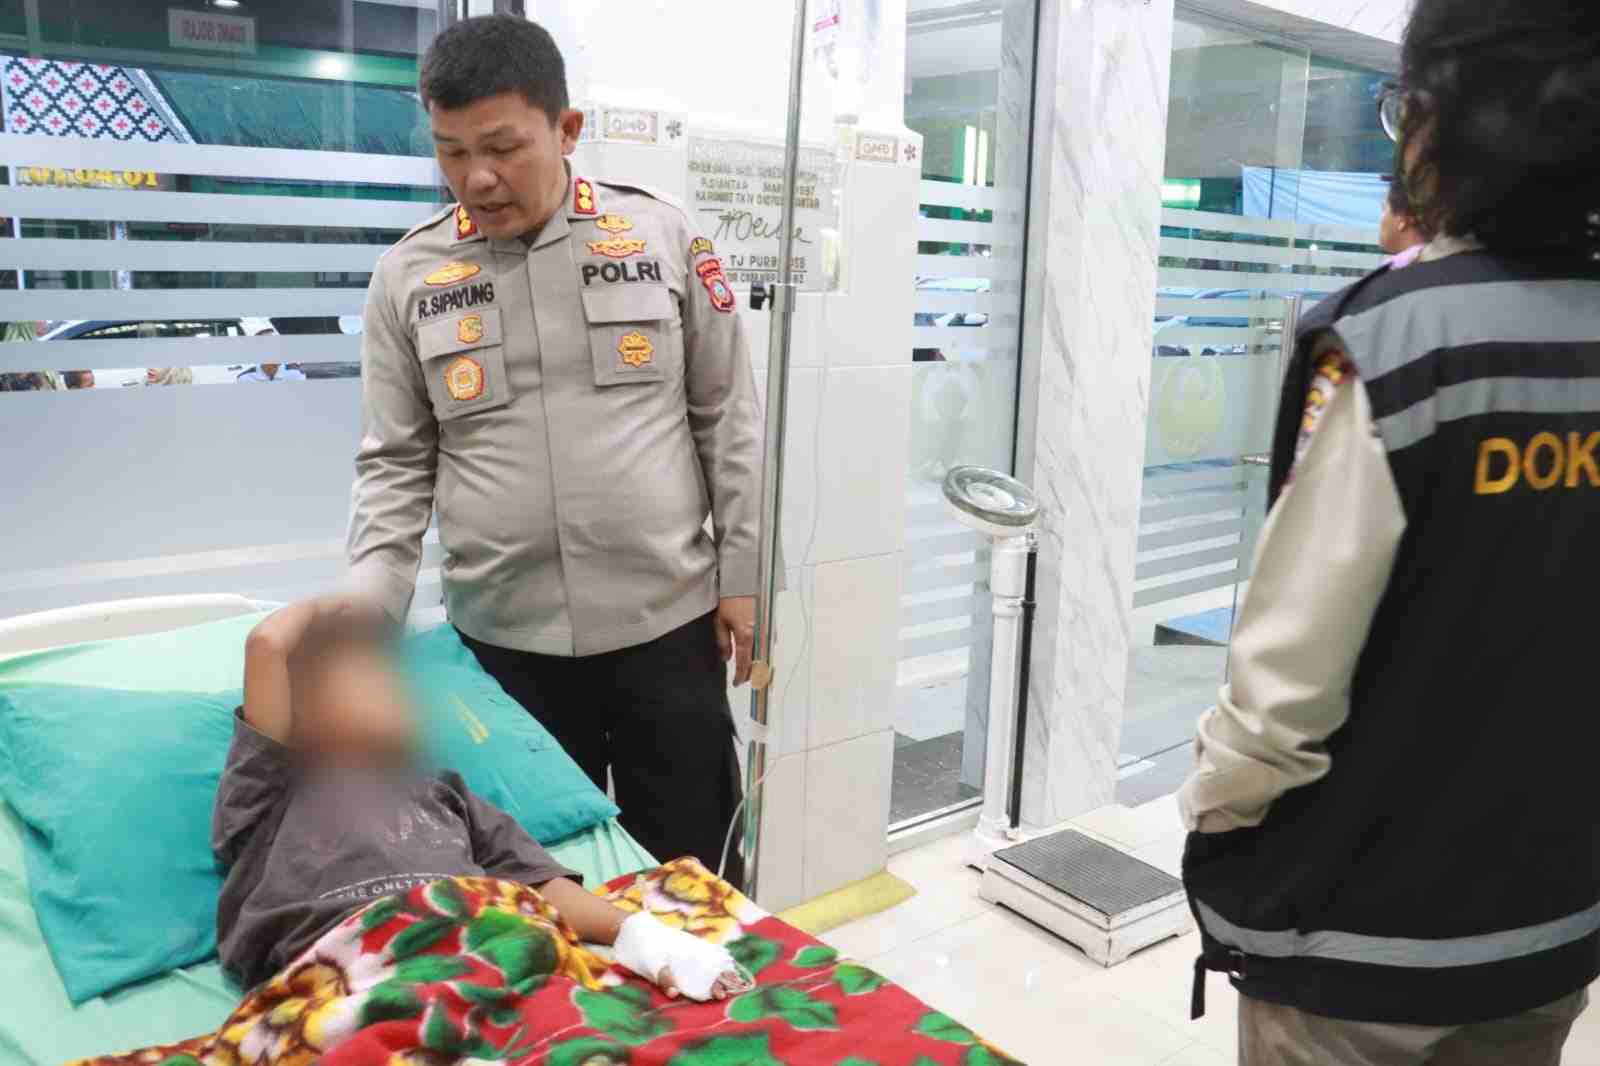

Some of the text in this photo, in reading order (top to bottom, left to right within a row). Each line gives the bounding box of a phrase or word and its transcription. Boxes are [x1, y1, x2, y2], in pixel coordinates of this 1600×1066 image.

[582, 261, 662, 286] POLRI
[418, 282, 495, 319] R.SIPAYUNG
[1474, 431, 1600, 495] DOK
